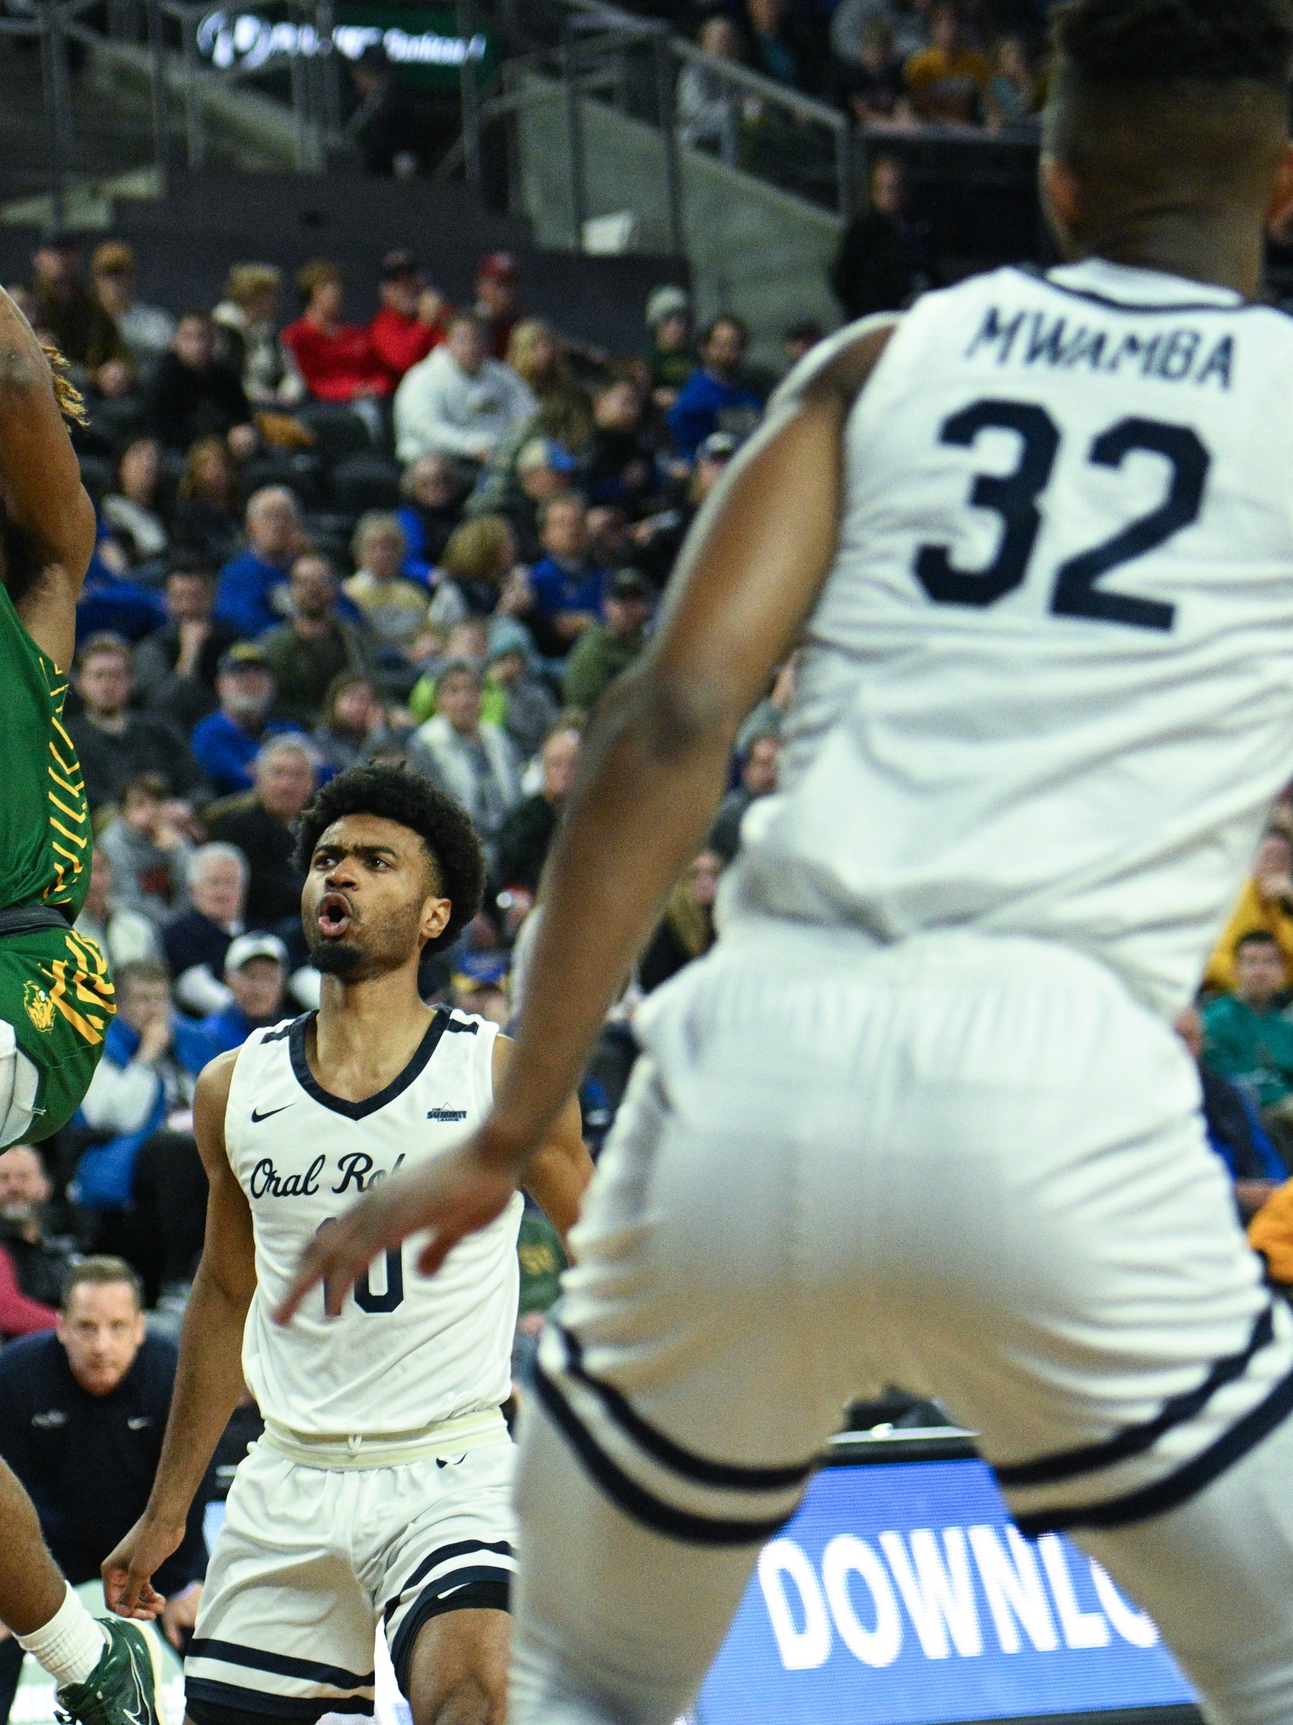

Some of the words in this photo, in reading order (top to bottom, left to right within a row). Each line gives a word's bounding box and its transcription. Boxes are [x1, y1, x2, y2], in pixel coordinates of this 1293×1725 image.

[964, 306, 1235, 391] MWAMBA
[913, 397, 1211, 632] 32
[426, 1110, 467, 1118] SUMMIT
[251, 1153, 326, 1199] Oral
